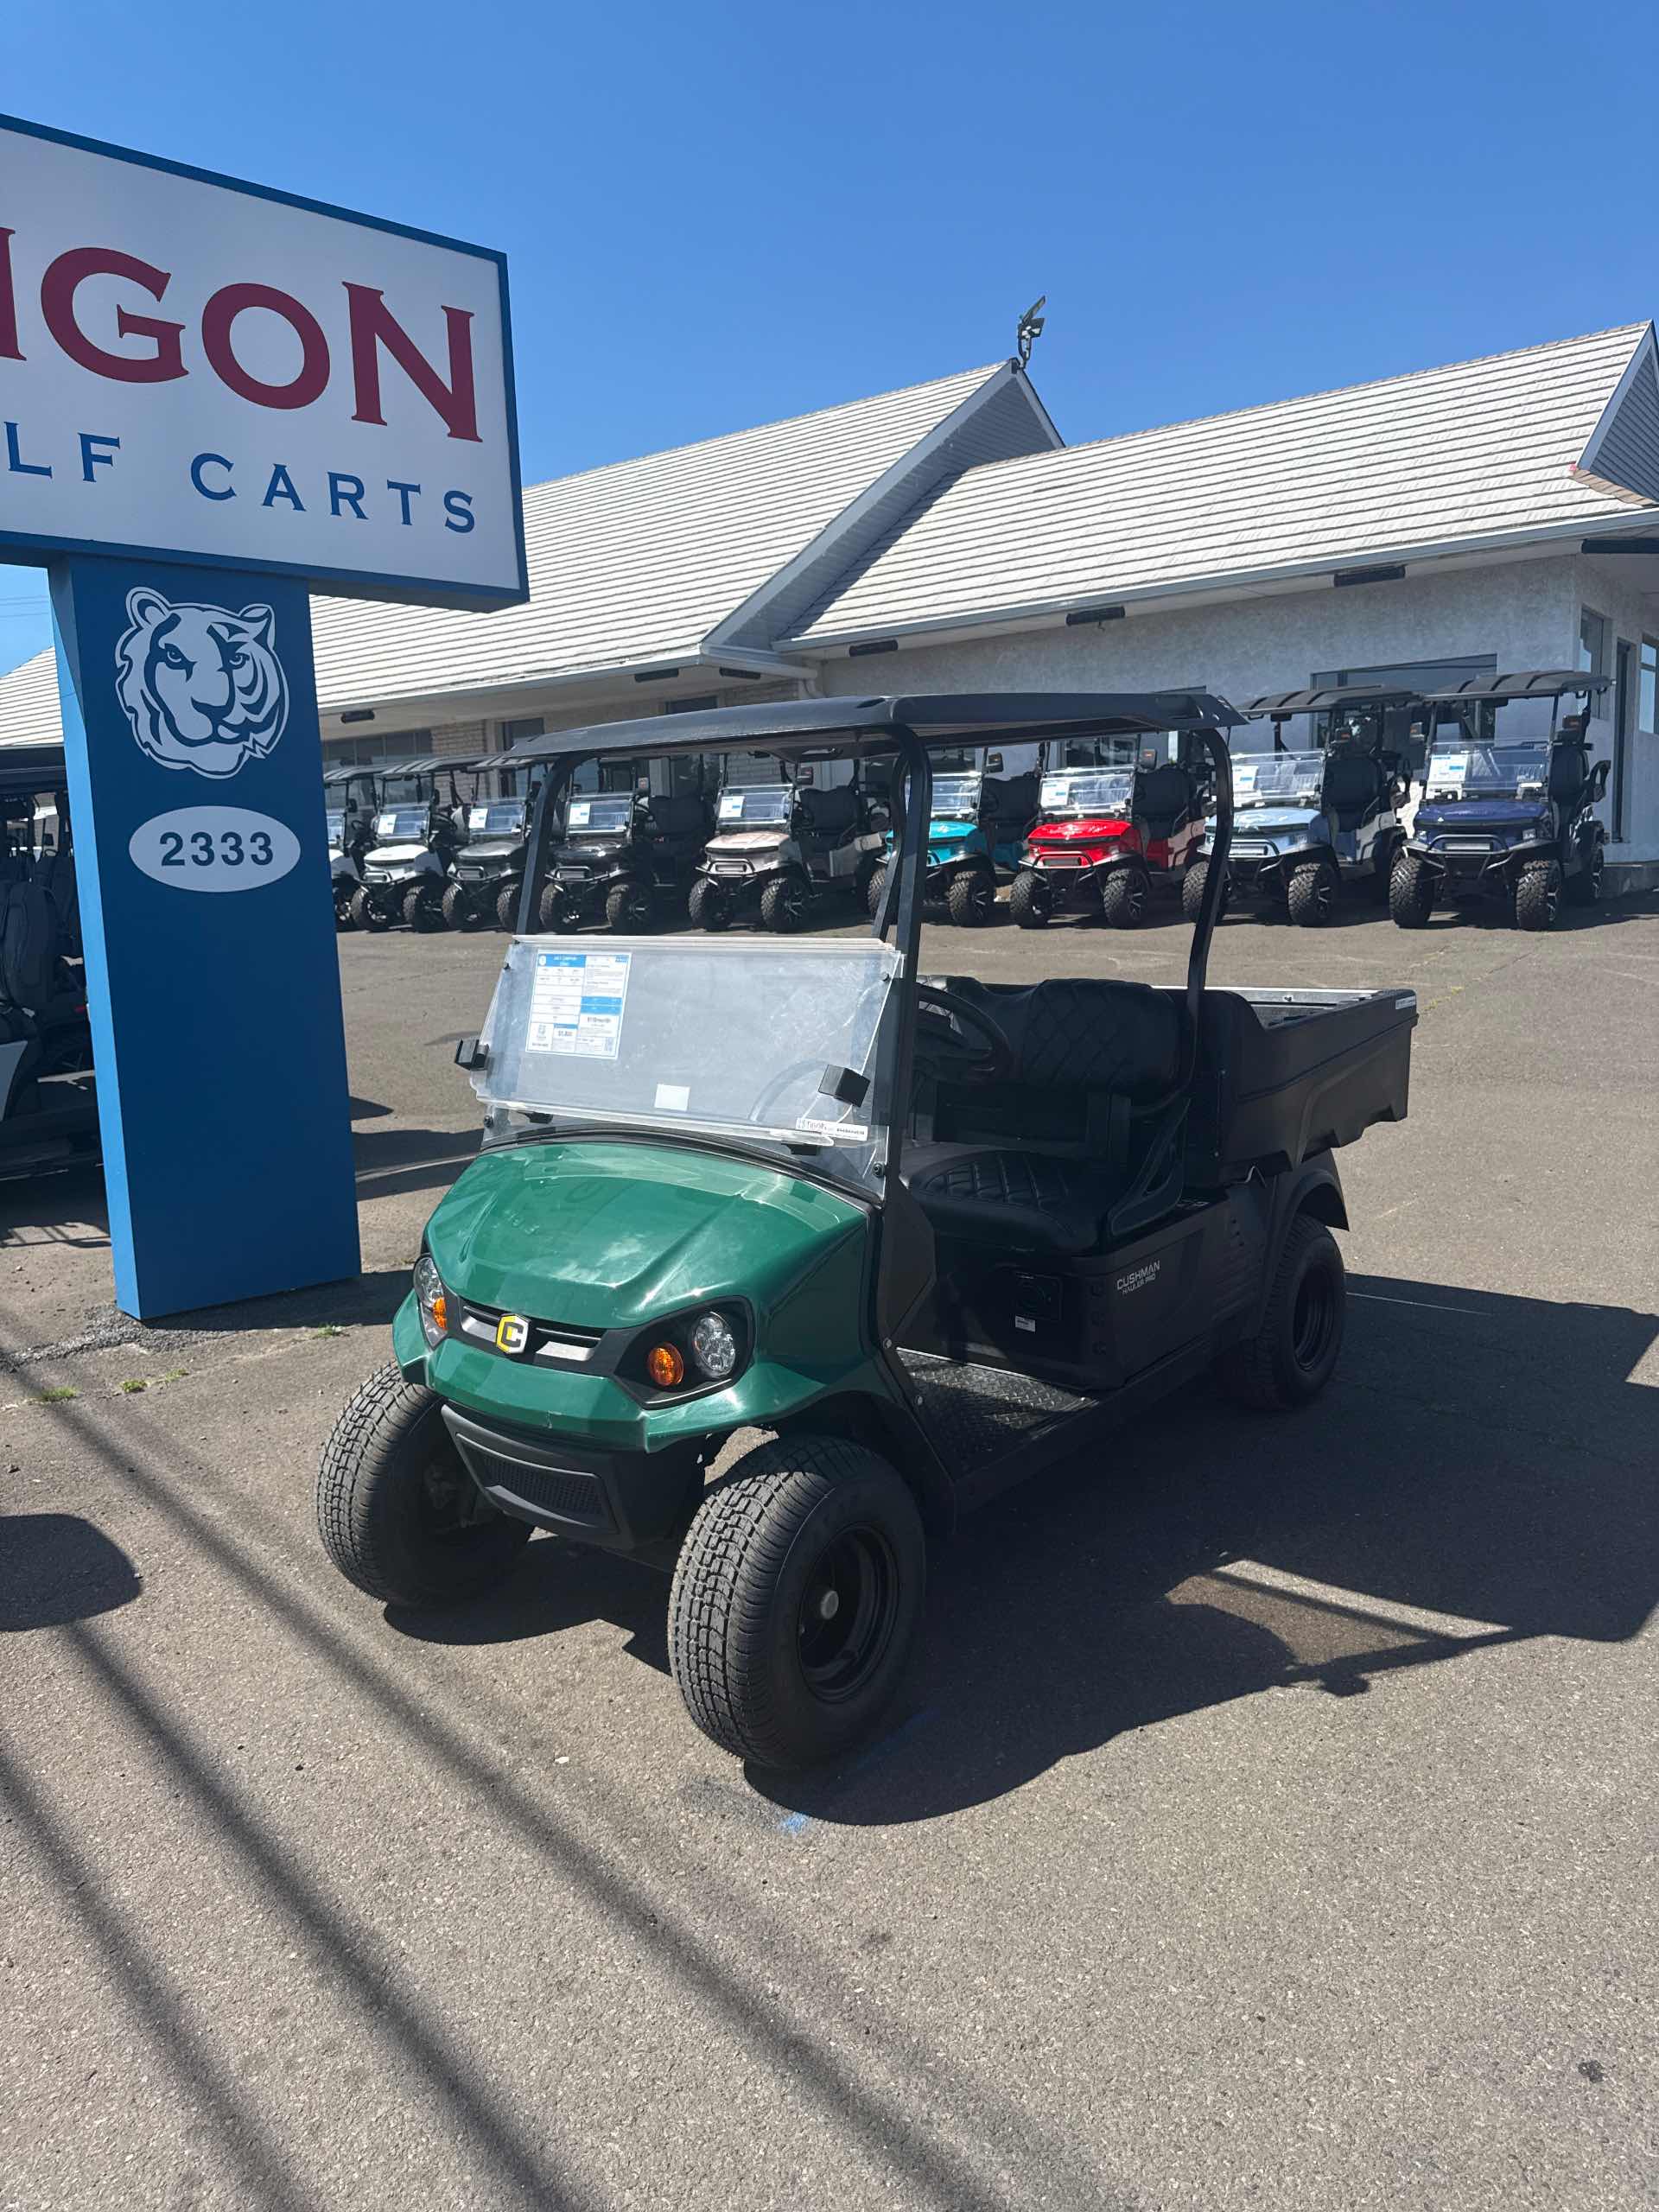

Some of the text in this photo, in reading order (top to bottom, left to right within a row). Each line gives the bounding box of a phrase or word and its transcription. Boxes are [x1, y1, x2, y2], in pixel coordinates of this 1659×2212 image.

[190, 452, 475, 533] CARTS
[159, 831, 274, 867] 2333
[1116, 1260, 1160, 1290] CUSHMAN
